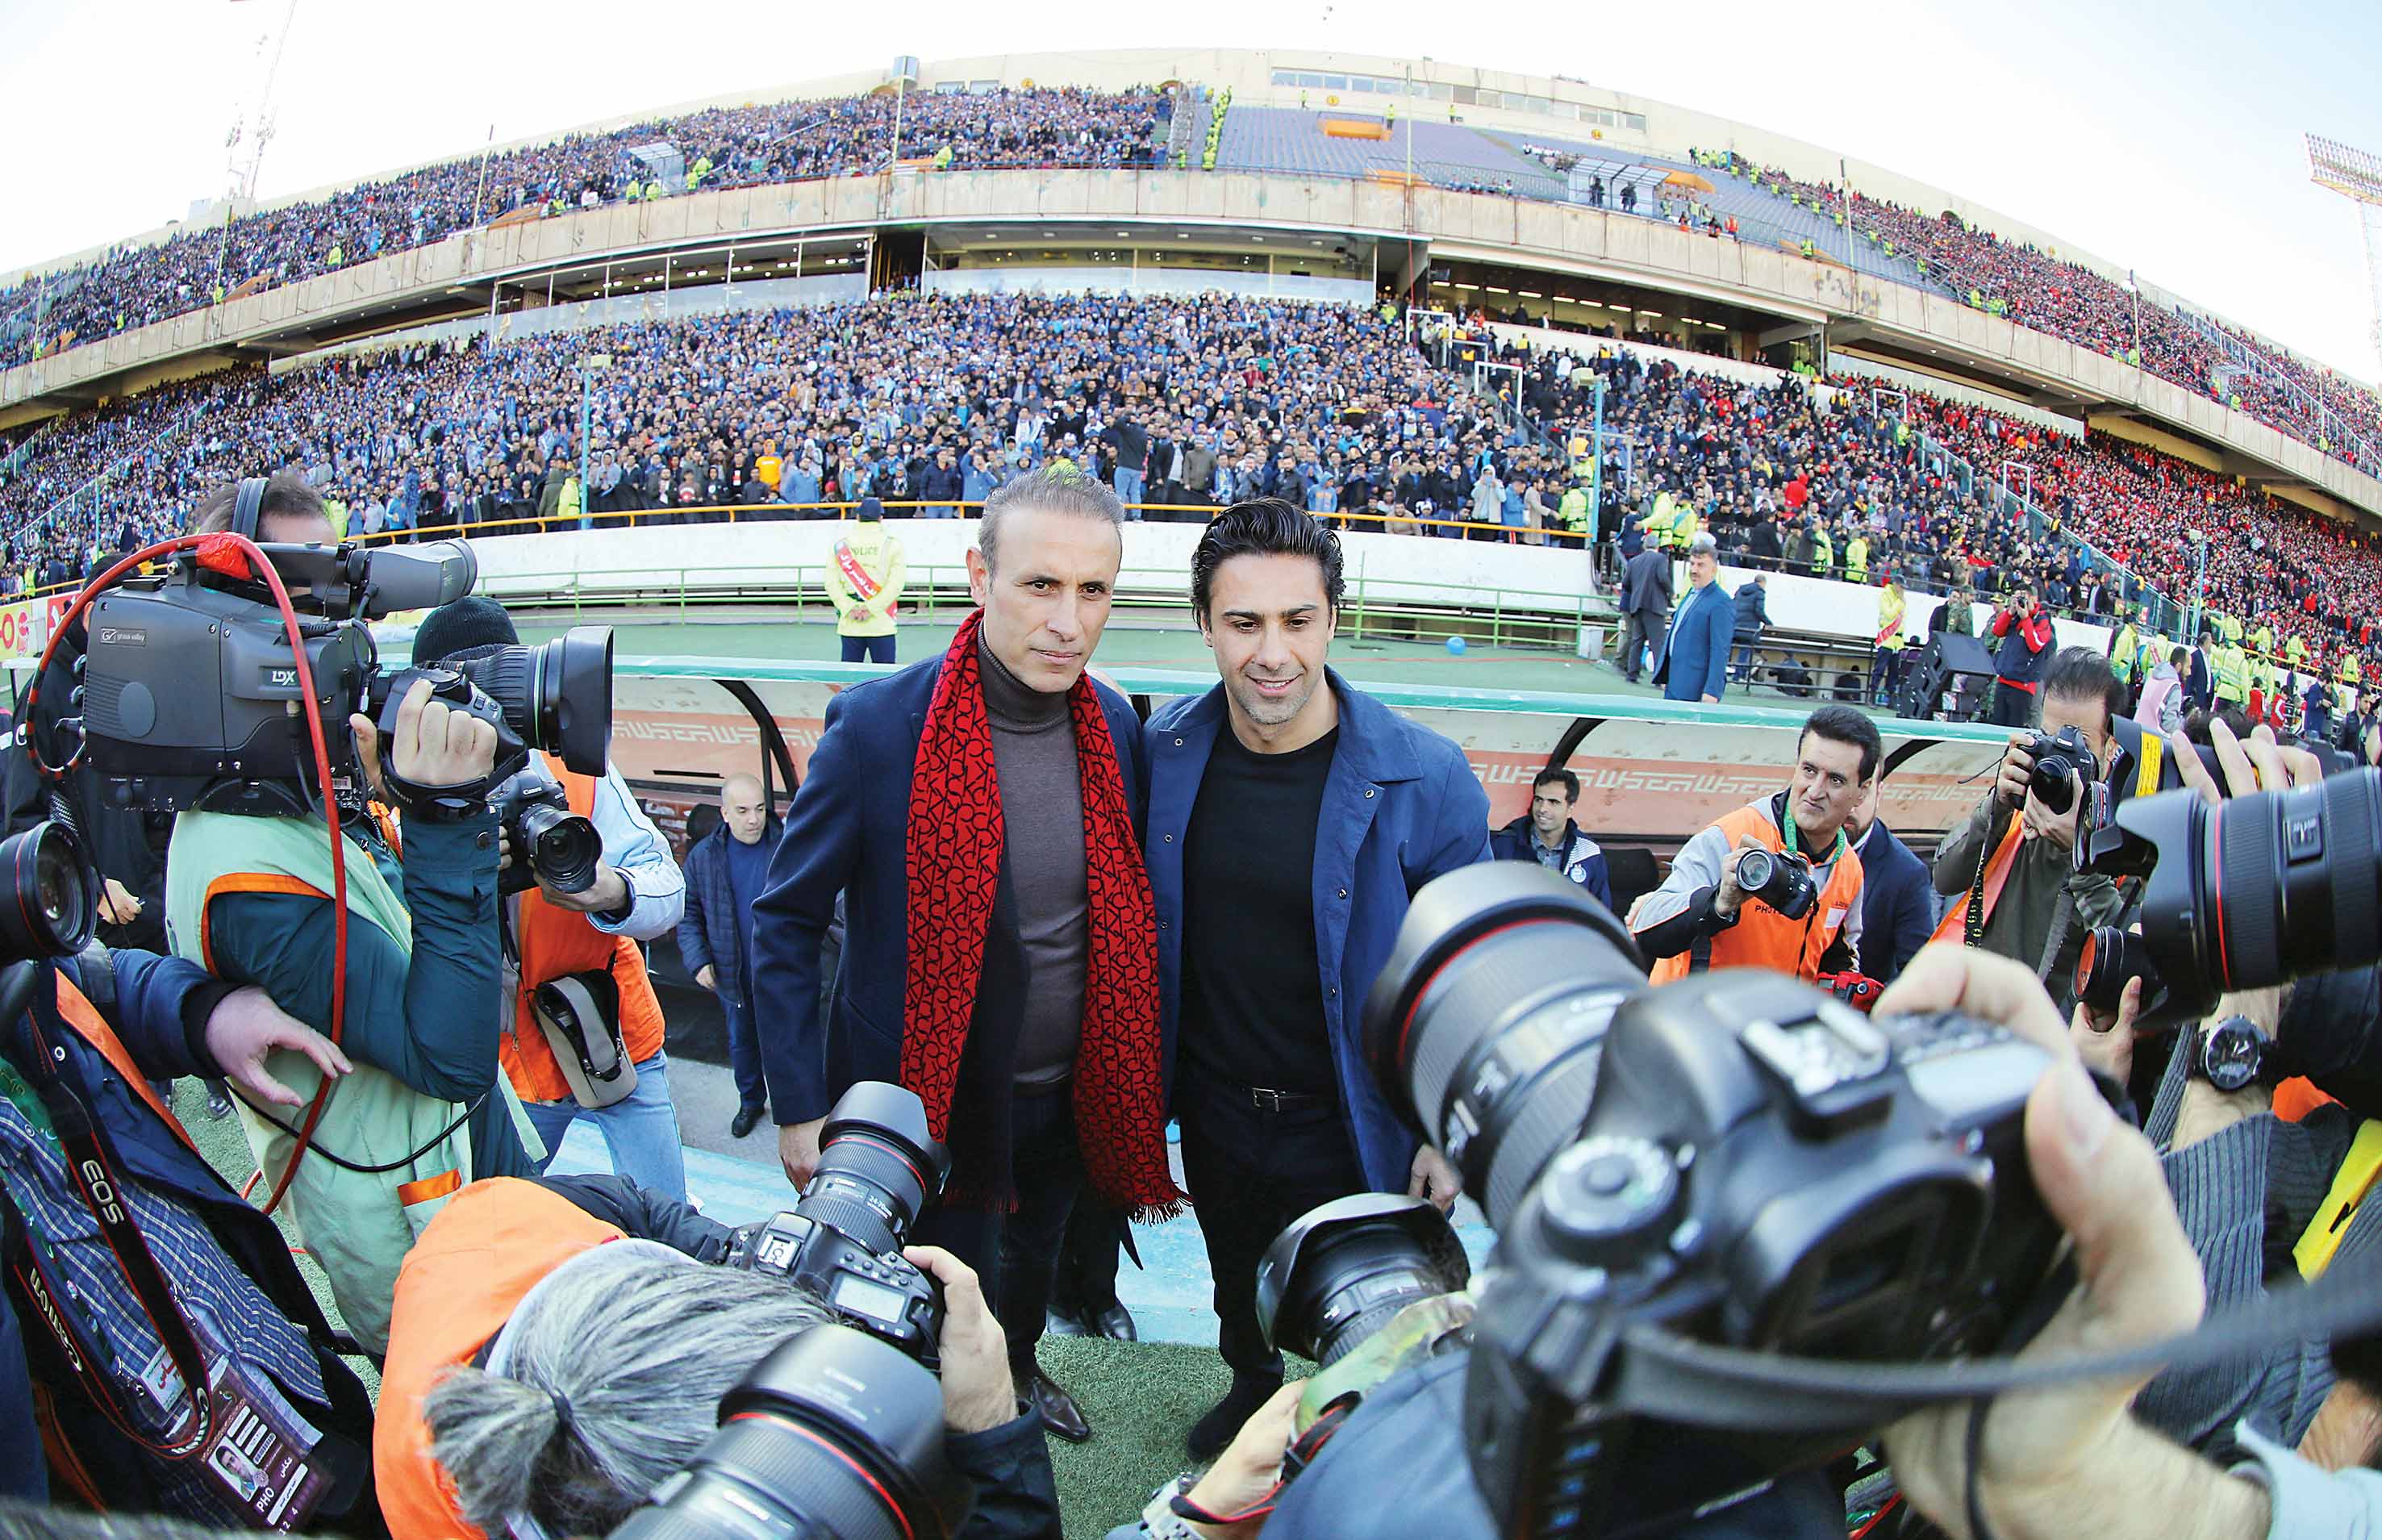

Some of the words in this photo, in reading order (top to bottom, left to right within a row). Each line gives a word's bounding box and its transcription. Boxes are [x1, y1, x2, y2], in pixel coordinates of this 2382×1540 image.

[271, 670, 296, 686] LDX
[82, 1159, 125, 1225] EOS
[30, 1267, 82, 1372] Canon
[256, 1486, 276, 1513] PHO
